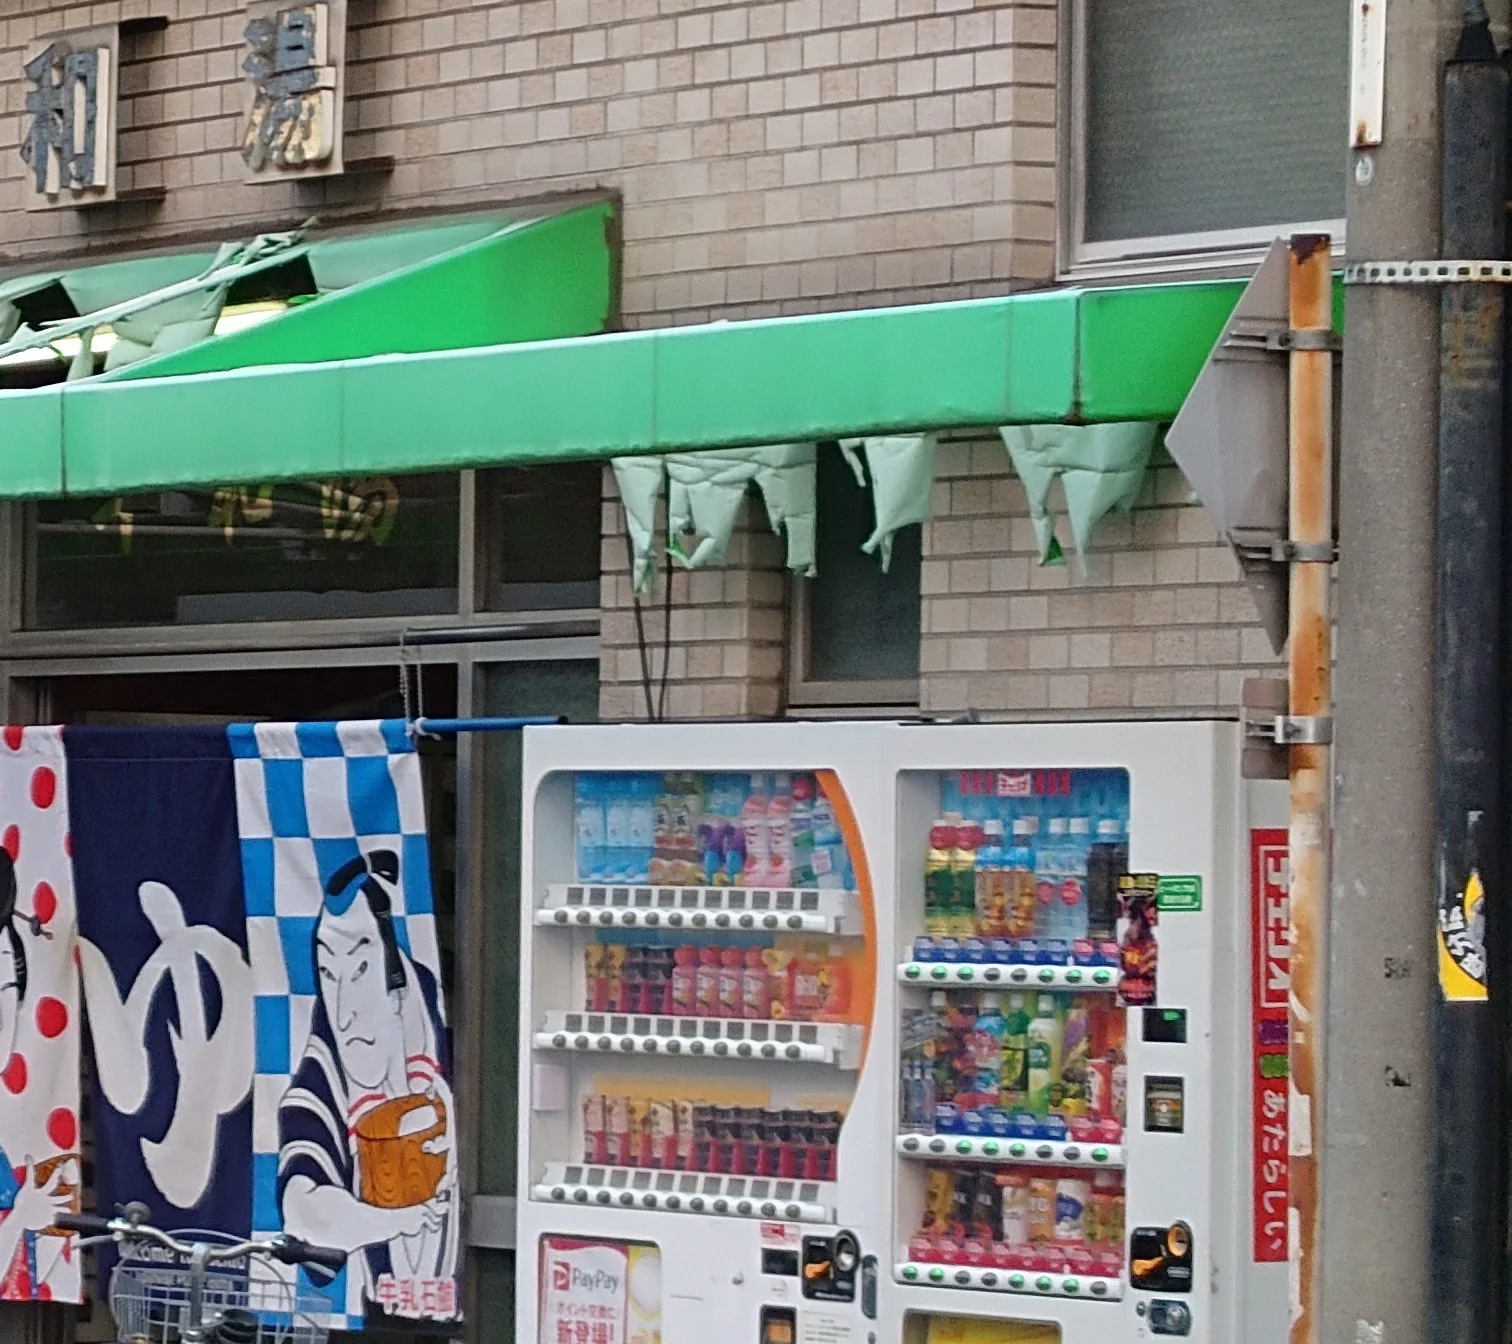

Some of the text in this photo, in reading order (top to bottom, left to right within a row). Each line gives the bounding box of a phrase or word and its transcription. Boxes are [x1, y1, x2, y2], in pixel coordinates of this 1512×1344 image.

[76, 880, 256, 1209] ゆ
[1262, 1089, 1288, 1251] あたらしい
[572, 1267, 621, 1294] PayPay
